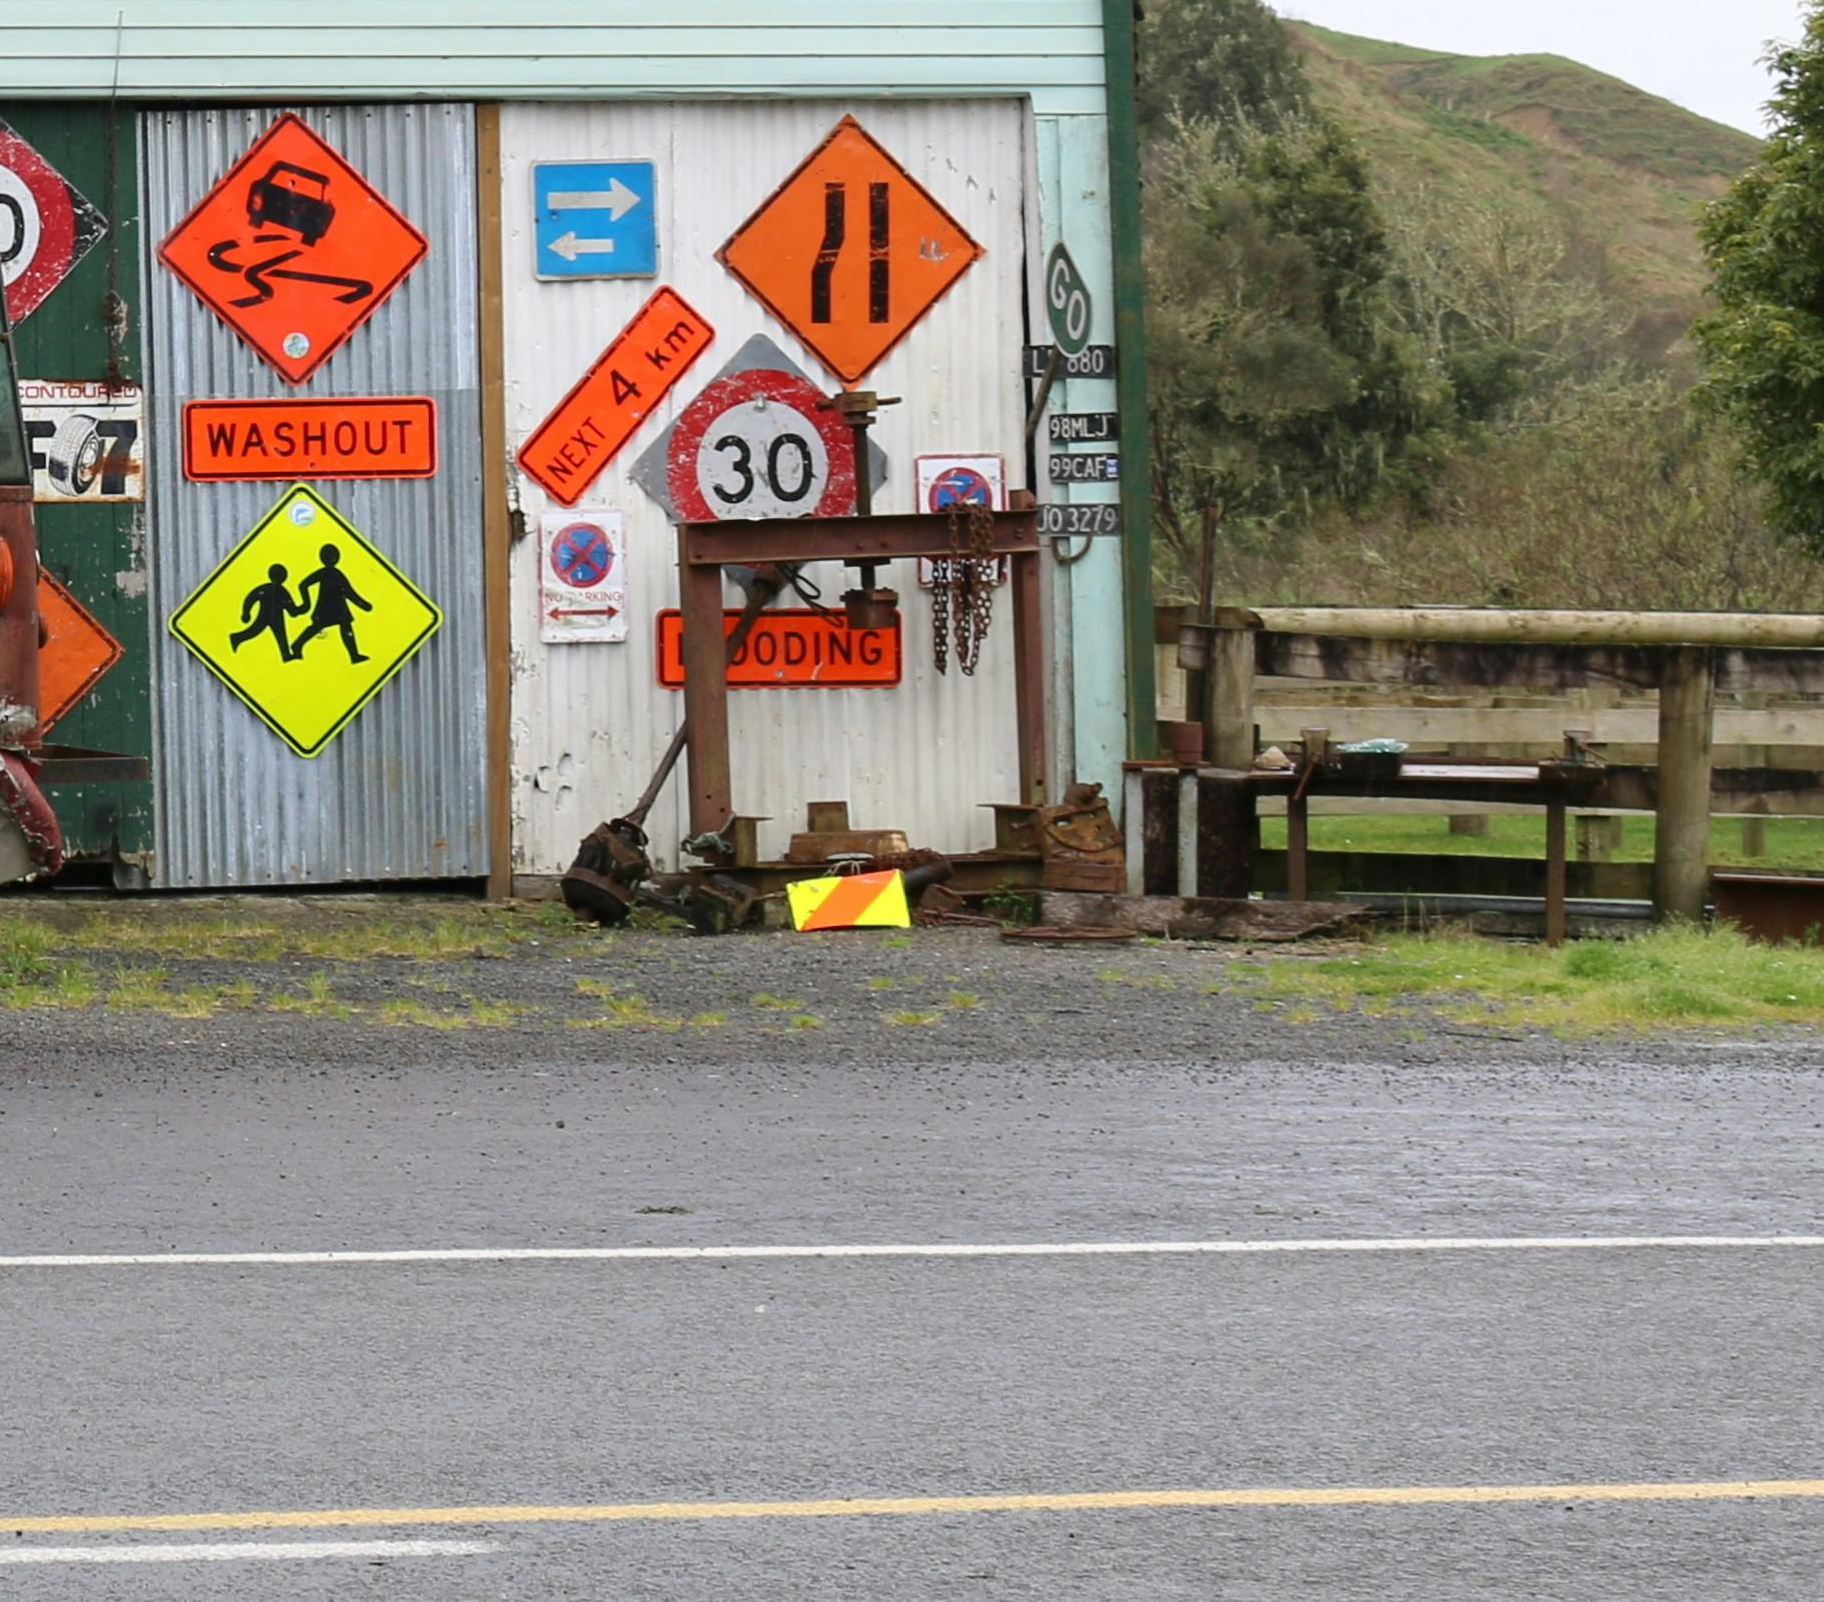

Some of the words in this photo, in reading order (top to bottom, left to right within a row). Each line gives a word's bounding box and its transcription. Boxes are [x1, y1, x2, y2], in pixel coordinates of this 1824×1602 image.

[1050, 258, 1086, 340] GO
[547, 416, 606, 484] NEXT
[609, 369, 642, 407] 4
[644, 319, 695, 372] km
[206, 419, 414, 457] WASHOUT
[1050, 414, 1108, 439] 98MLJ
[712, 432, 815, 505] 30
[1050, 456, 1107, 478] 99CAF
[1067, 507, 1117, 533] 3279
